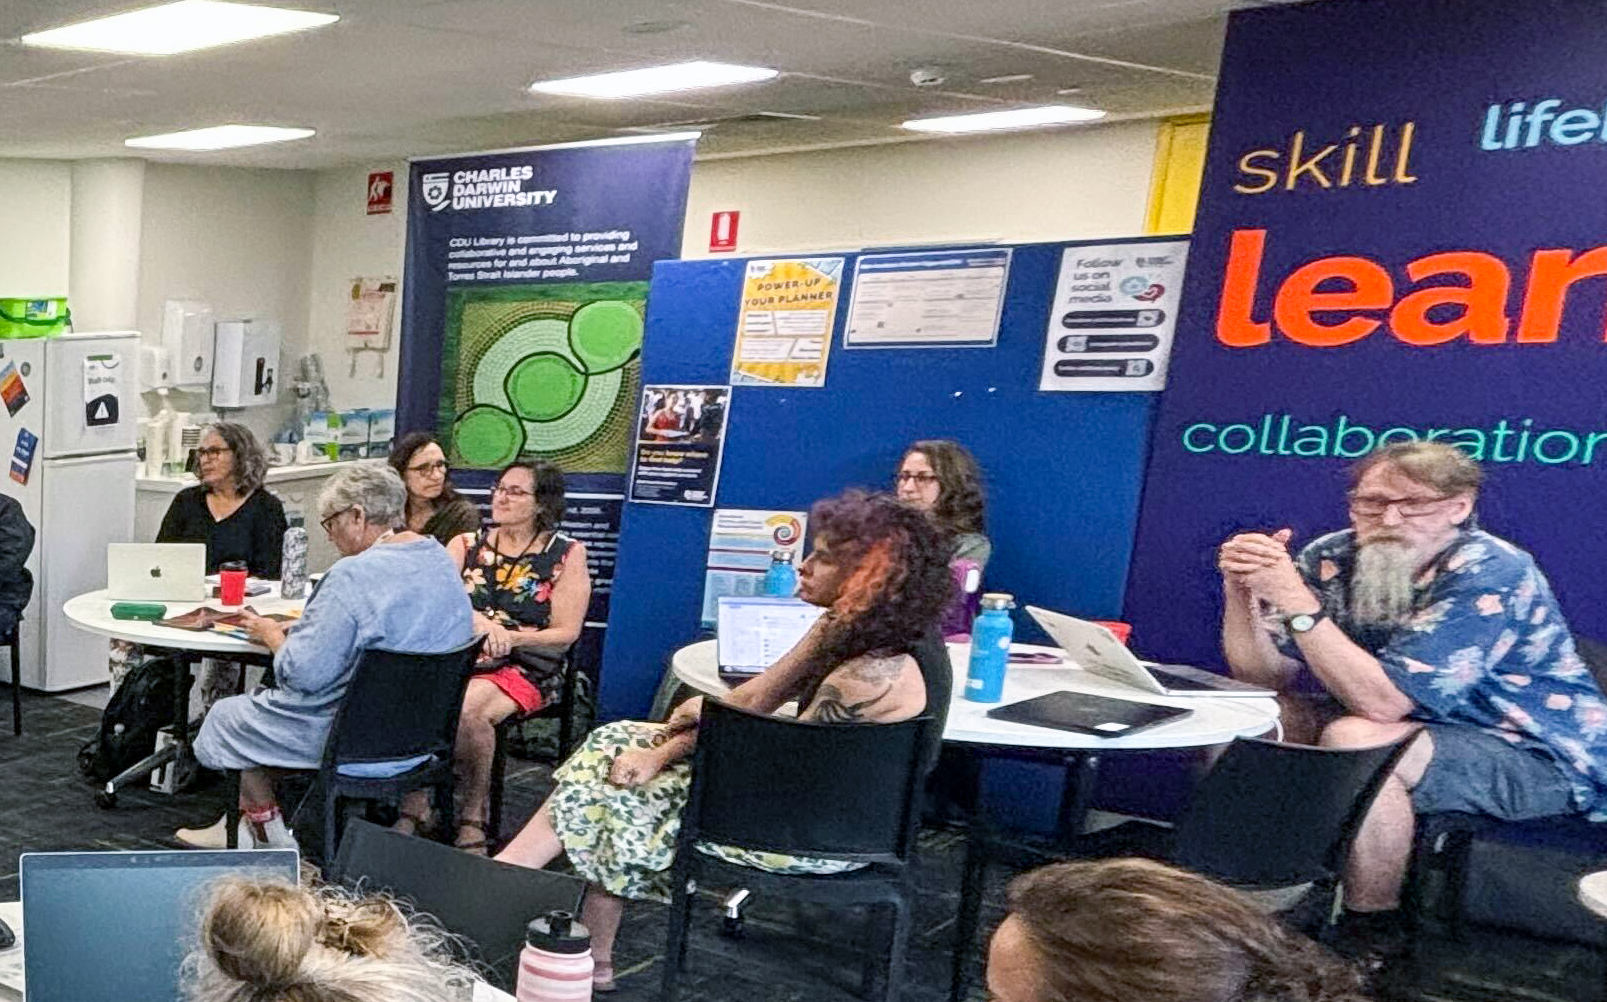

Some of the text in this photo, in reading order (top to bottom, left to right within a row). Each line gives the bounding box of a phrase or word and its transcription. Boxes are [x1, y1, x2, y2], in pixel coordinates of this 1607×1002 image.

[1481, 99, 1607, 150] life
[1233, 121, 1418, 194] skill
[453, 165, 533, 184] CHARLES
[453, 180, 521, 197] DARWIN
[453, 190, 557, 210] UNIVERSITY
[1077, 259, 1123, 268] Follow
[756, 278, 822, 292] POWER-UP
[1215, 228, 1607, 347] lear
[745, 291, 833, 306] YOUR PLANNER
